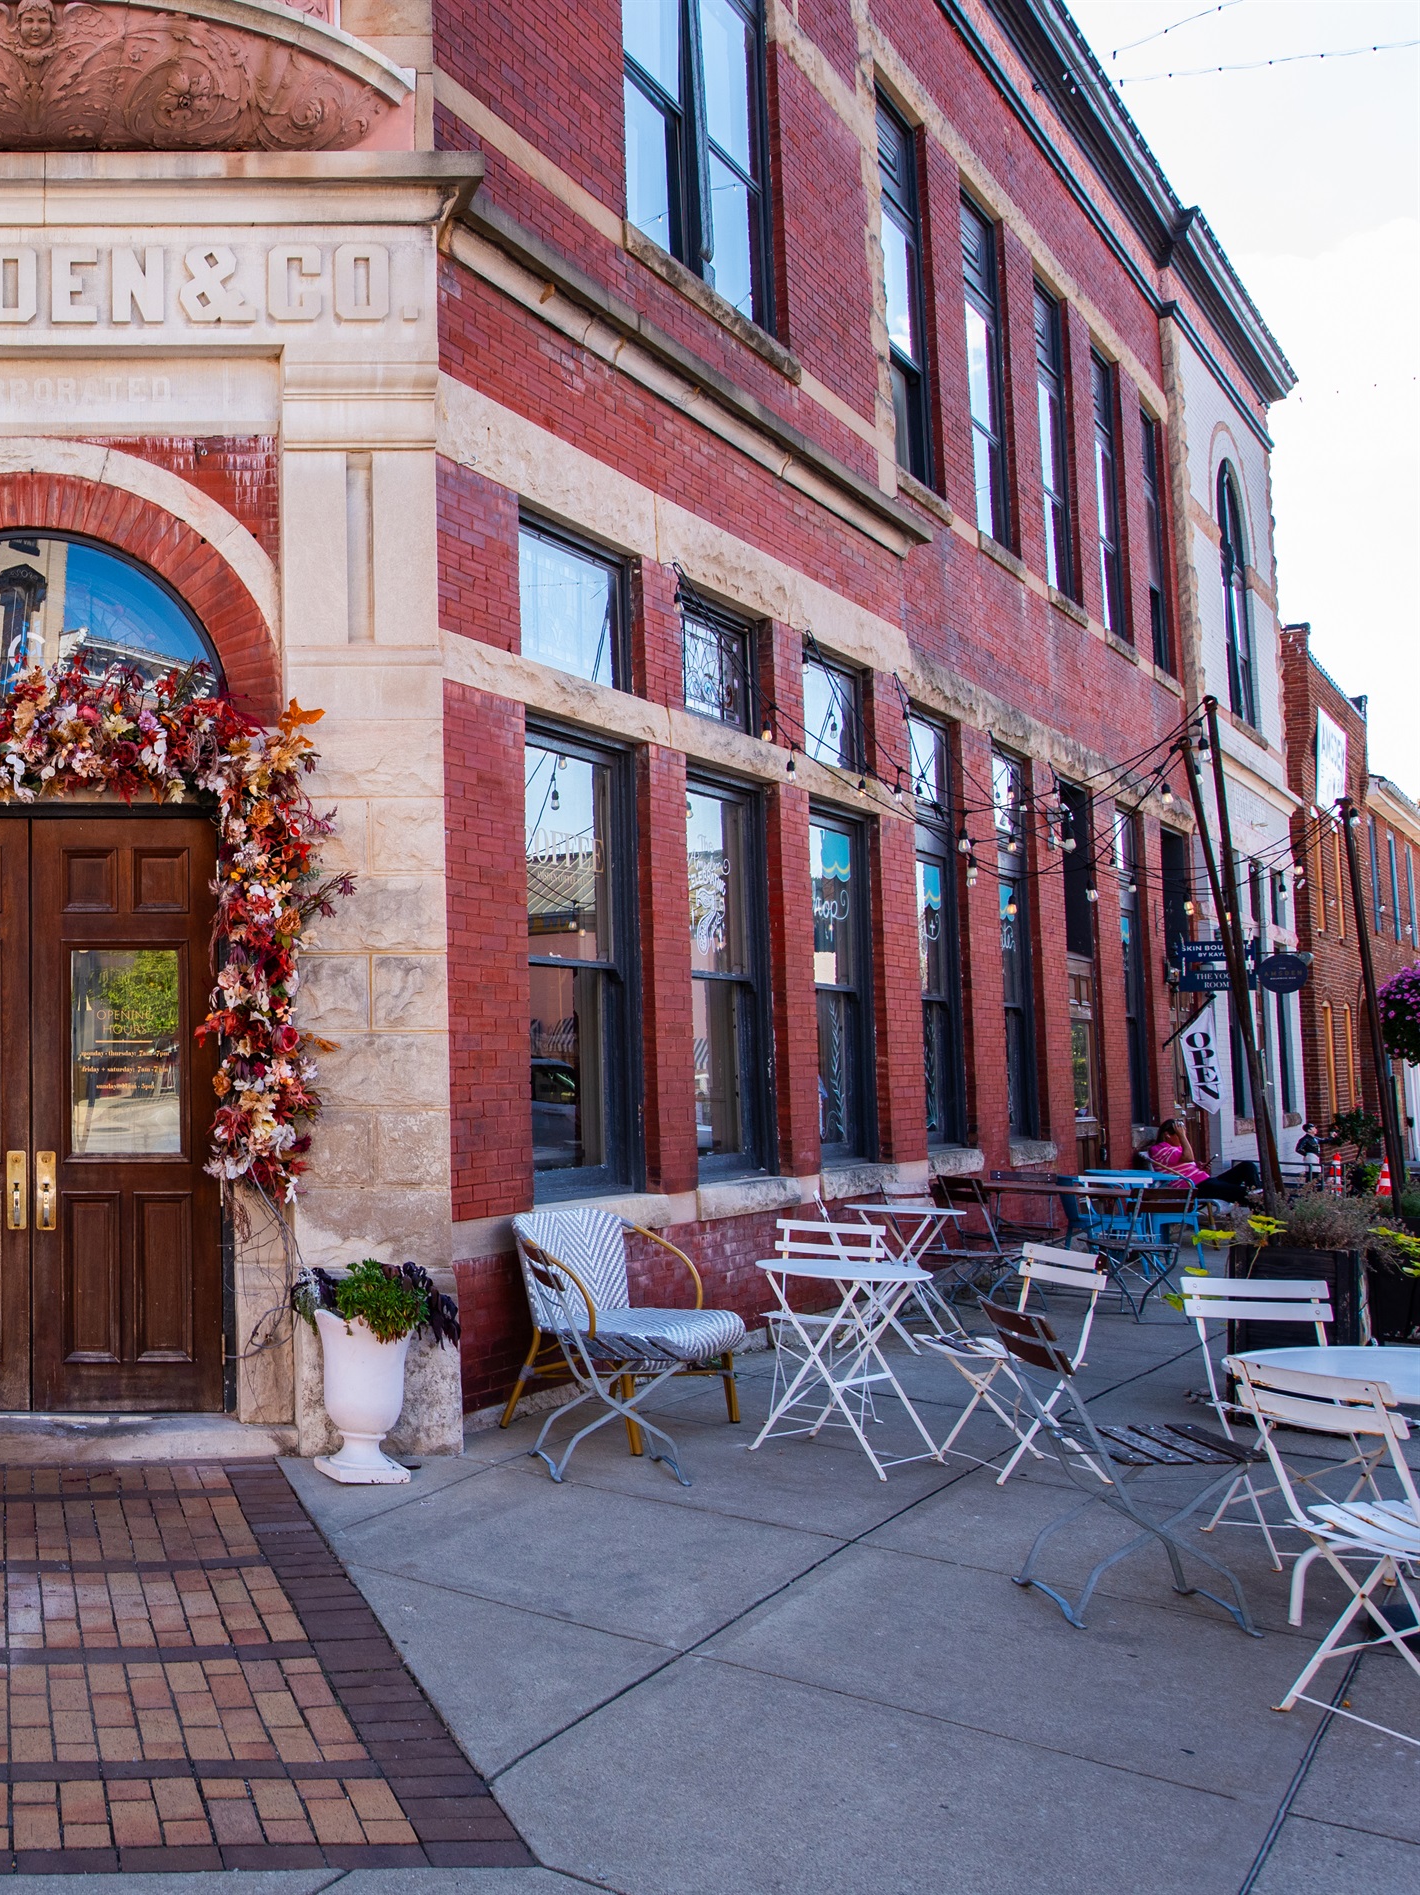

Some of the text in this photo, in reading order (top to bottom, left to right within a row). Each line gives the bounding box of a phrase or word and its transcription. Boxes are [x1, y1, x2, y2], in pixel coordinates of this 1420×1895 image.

[96, 1009, 154, 1021] OPENING
[102, 1024, 147, 1035] HOURS
[1185, 1032, 1220, 1101] OPEN
